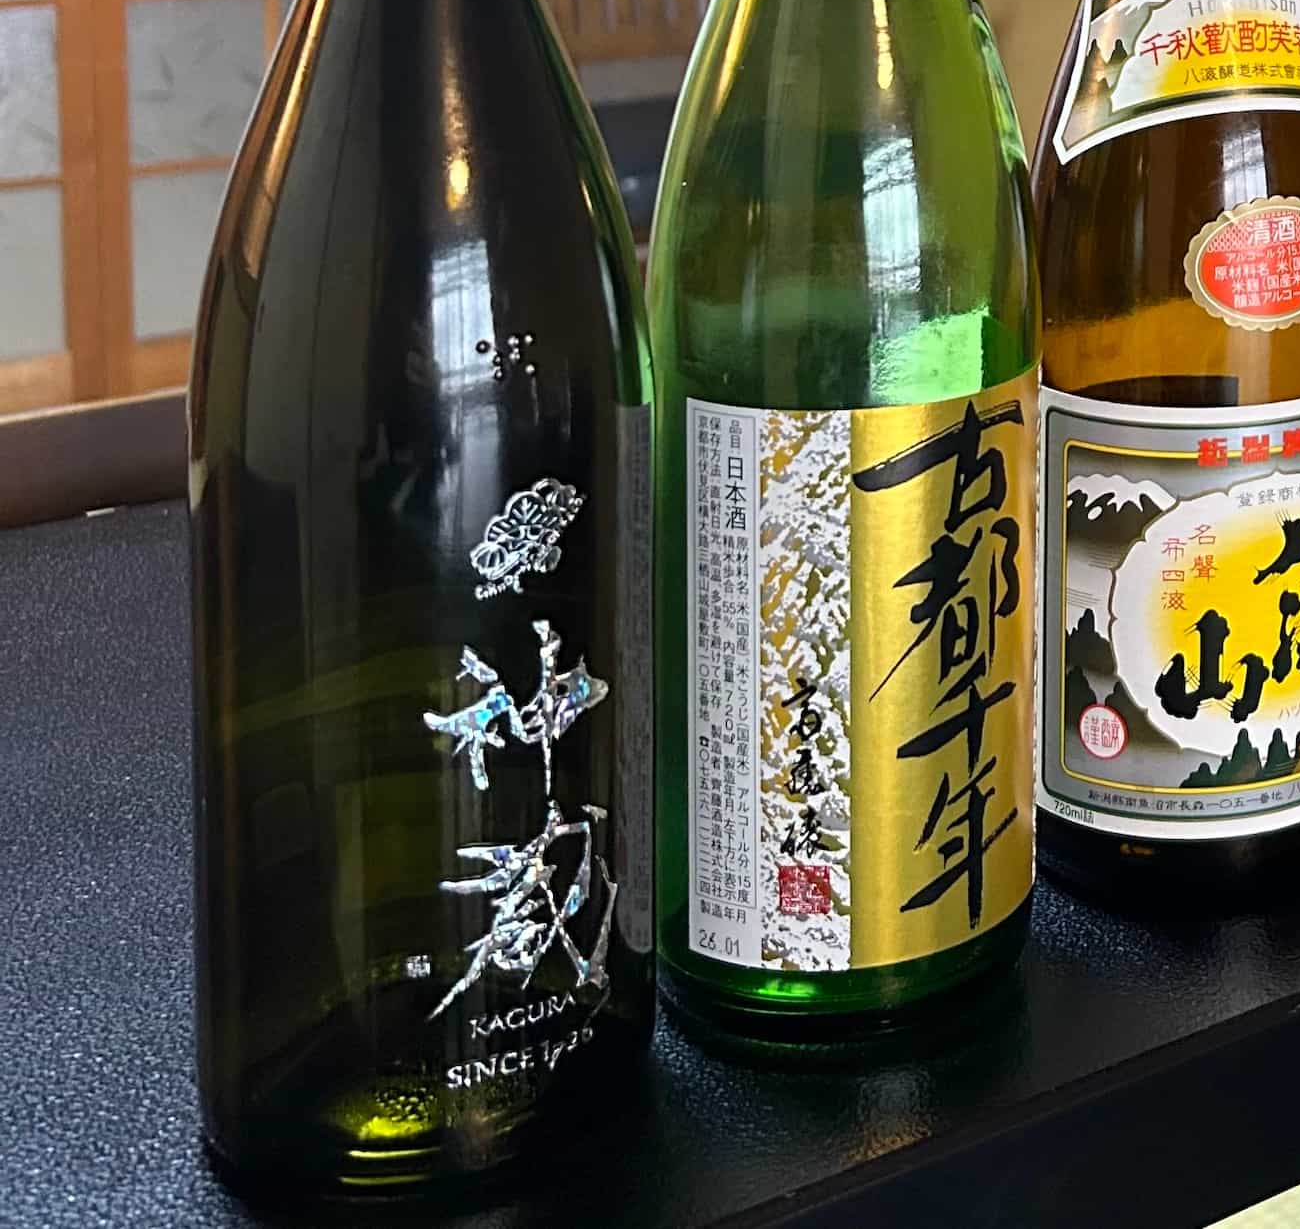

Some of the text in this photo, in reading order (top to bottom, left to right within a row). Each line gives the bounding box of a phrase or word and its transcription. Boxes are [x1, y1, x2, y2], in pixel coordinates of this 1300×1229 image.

[1246, 215, 1296, 246] 清酒
[725, 456, 748, 531] 日本酒
[852, 399, 1024, 931] 古都千年
[700, 899, 748, 924] 製造年月
[698, 928, 741, 957] 26.01
[469, 990, 577, 1040] KAGURA
[446, 1045, 536, 1089] SINCE
